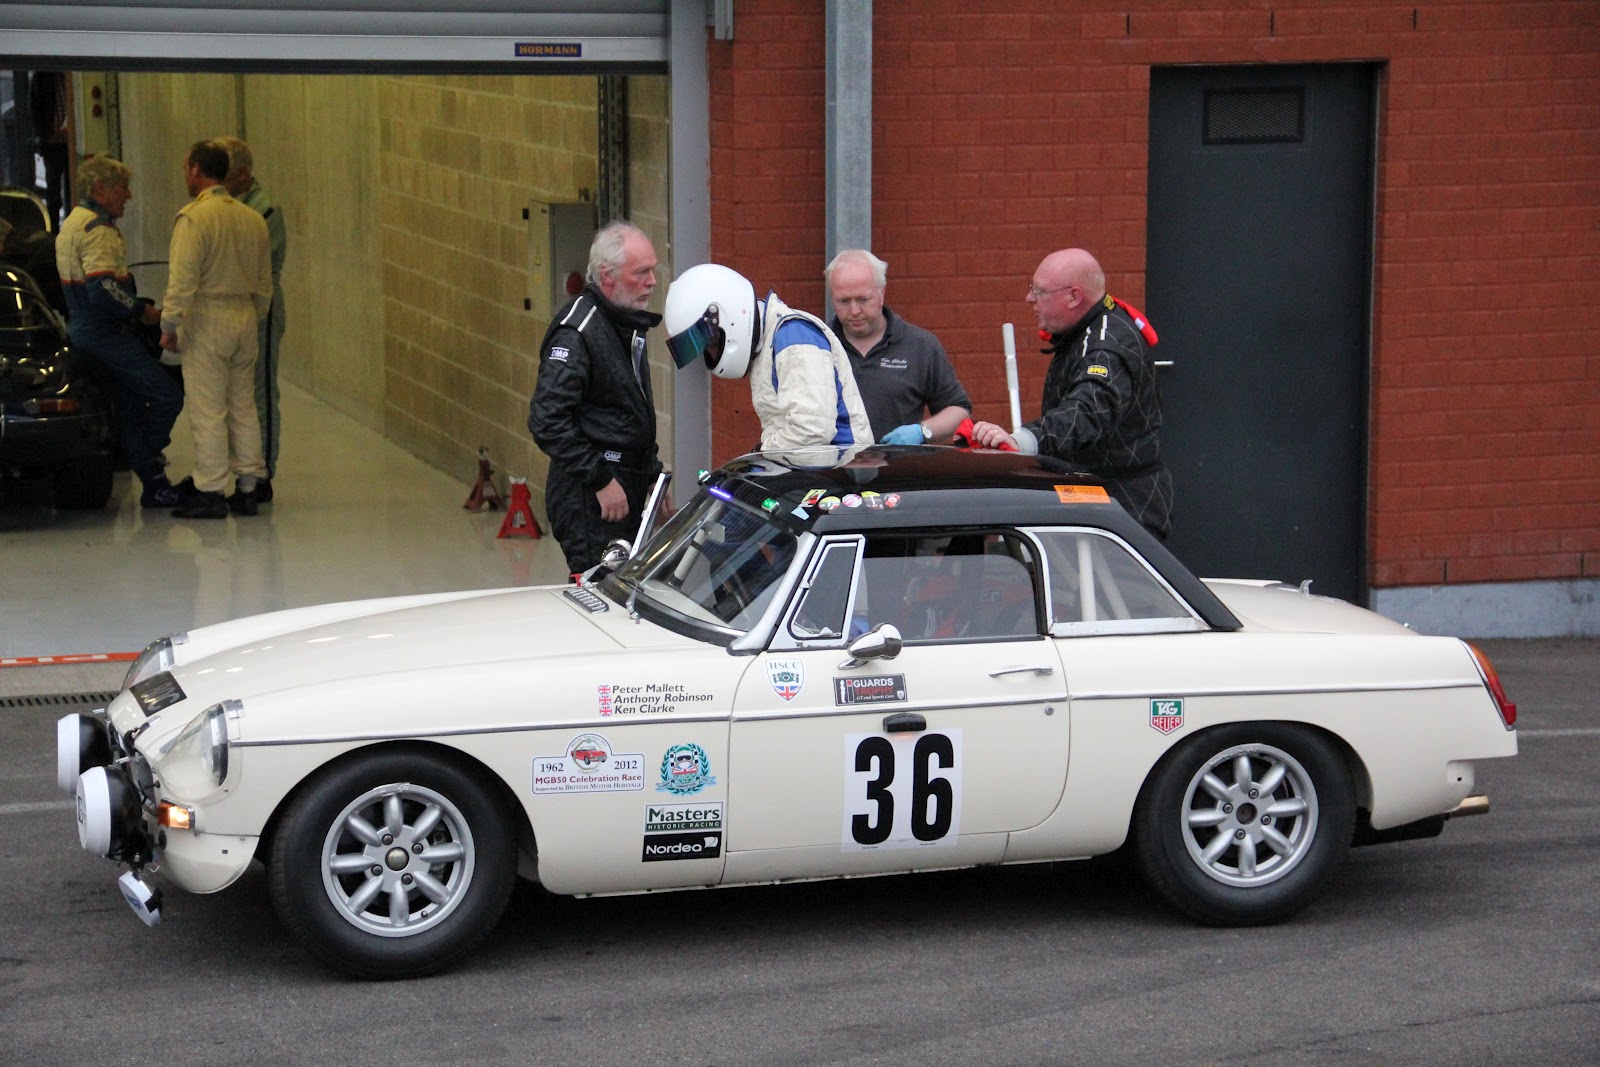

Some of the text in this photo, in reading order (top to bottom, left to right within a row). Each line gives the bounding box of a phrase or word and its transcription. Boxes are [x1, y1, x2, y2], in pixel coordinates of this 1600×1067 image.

[769, 660, 800, 670] HSCC
[612, 683, 685, 694] Peter Mallett
[853, 677, 894, 688] GUARDS
[855, 686, 894, 696] TROPHY
[614, 693, 713, 705] Anthony Robinson
[615, 704, 675, 715] Ken Clarke
[1156, 701, 1179, 715] TAG
[1153, 717, 1181, 731] HEUER
[540, 760, 638, 773] 1962 2012
[535, 776, 567, 784] MGB50
[569, 774, 620, 783] Celebration
[852, 733, 954, 845] 36
[648, 807, 720, 823] Masters
[645, 842, 703, 855] Nordea
